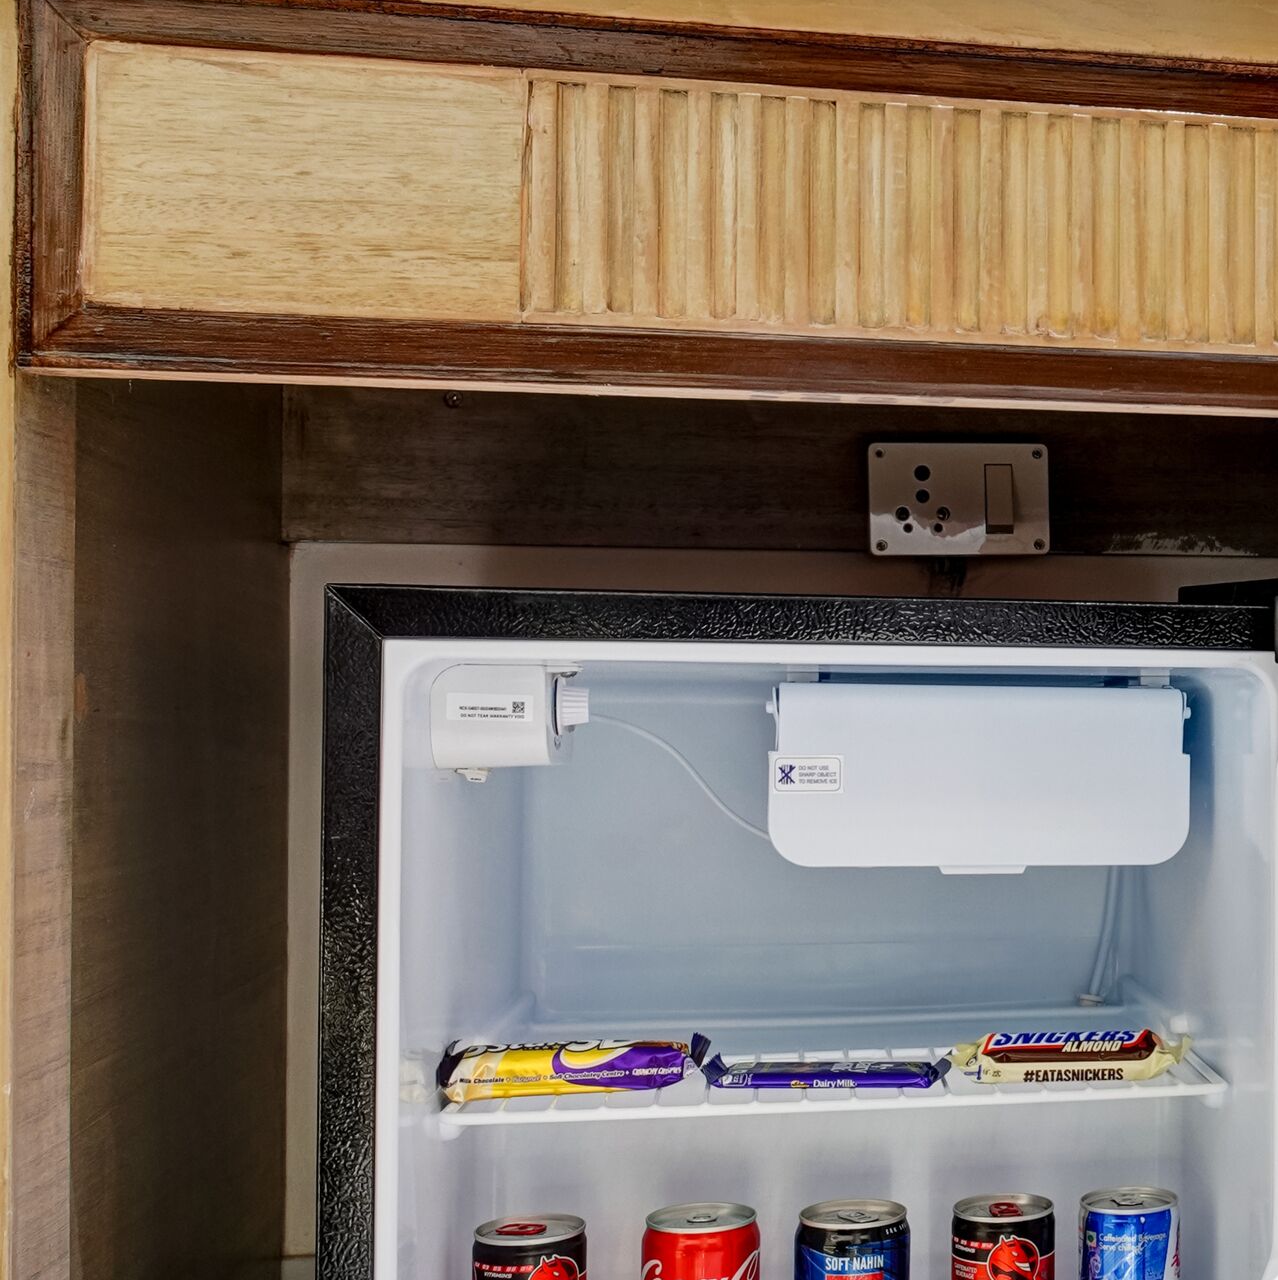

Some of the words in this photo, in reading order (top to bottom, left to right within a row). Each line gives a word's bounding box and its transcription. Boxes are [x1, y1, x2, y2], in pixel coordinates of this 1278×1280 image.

[1061, 1040, 1123, 1053] ALMOND
[1023, 1068, 1124, 1083] #EATASNICKERS
[813, 1079, 836, 1089] Dairy
[836, 1079, 857, 1088] Milk
[824, 1257, 851, 1271] SOFT
[852, 1254, 884, 1270] NAHIN
